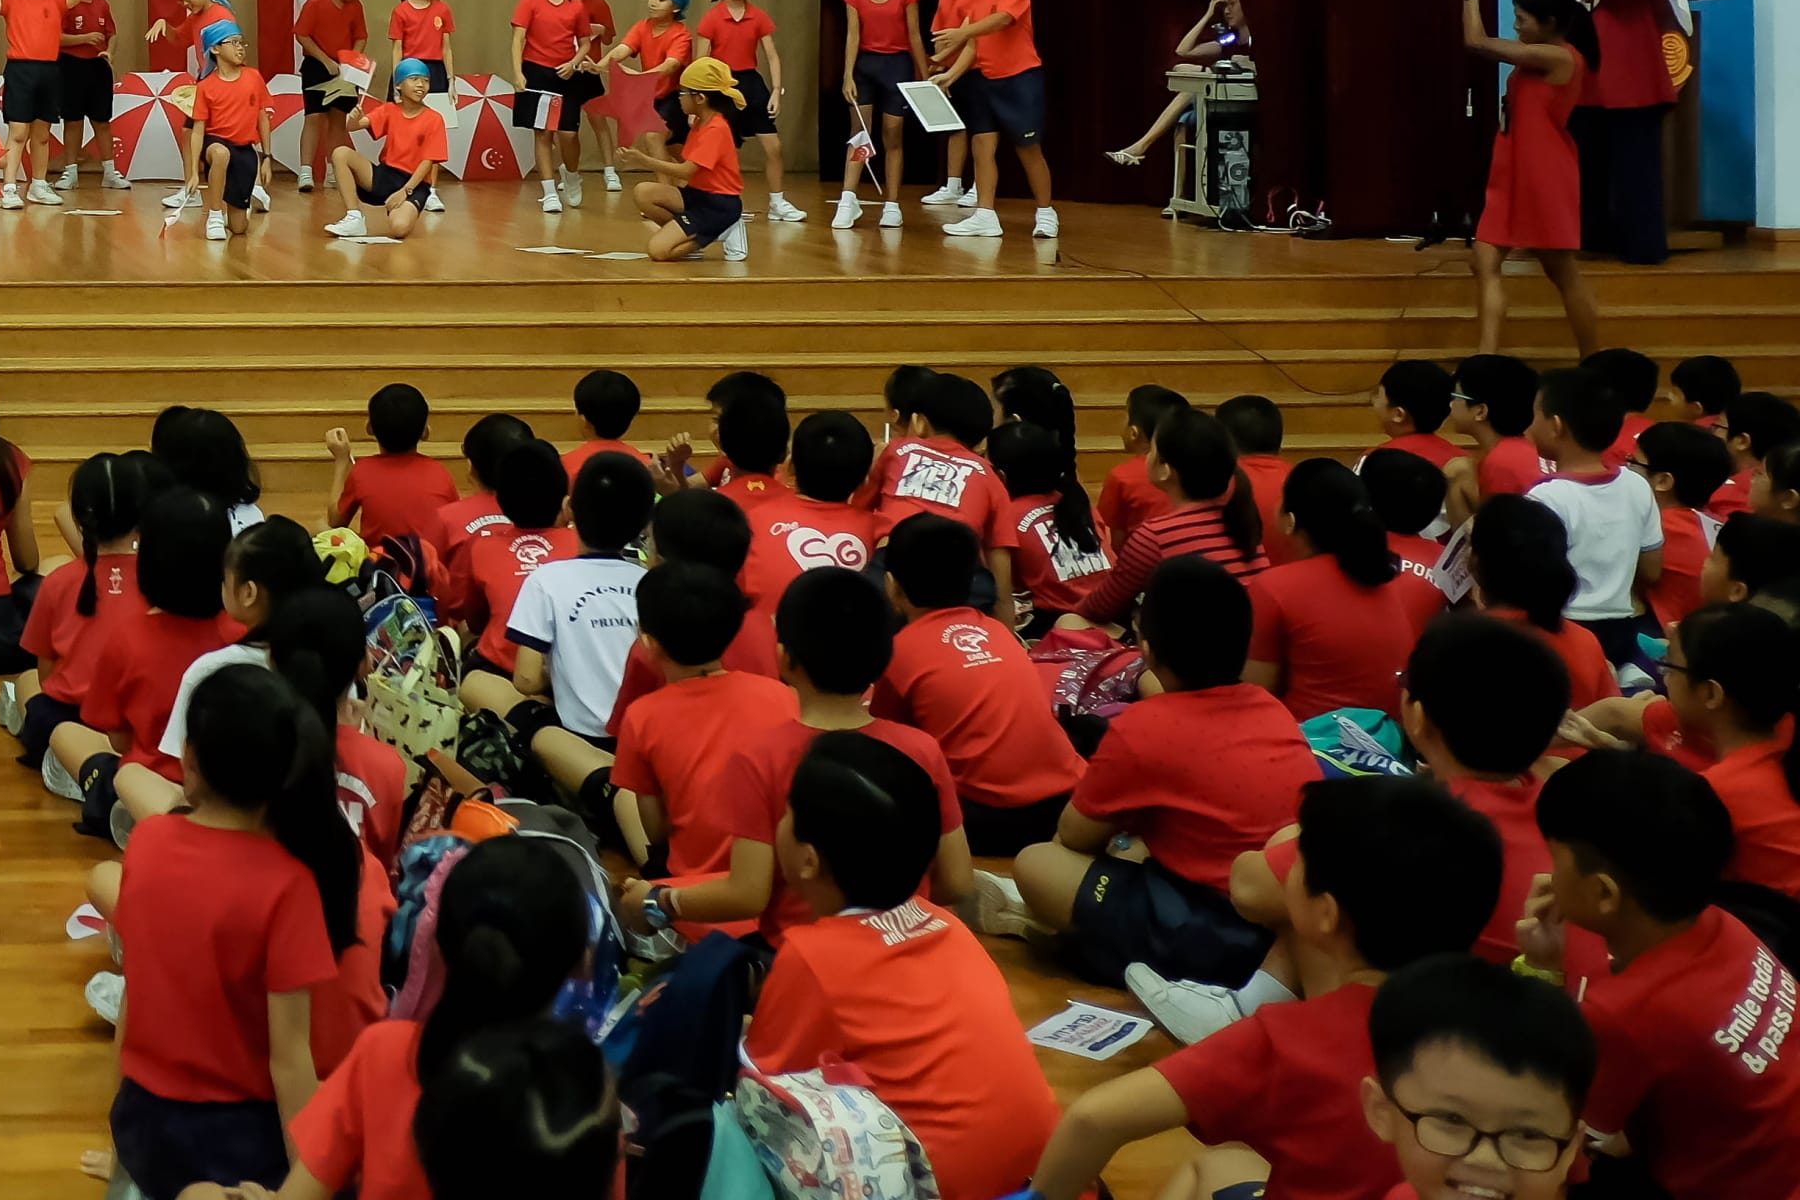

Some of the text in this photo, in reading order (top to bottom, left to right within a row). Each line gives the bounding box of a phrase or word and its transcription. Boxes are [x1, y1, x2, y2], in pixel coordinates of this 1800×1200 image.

[768, 521, 799, 536] One
[1401, 558, 1441, 589] POR
[1714, 946, 1777, 1054] Smile today
[1773, 990, 1798, 1012] it
[1758, 1005, 1794, 1061] pass
[1741, 1051, 1769, 1075] &
